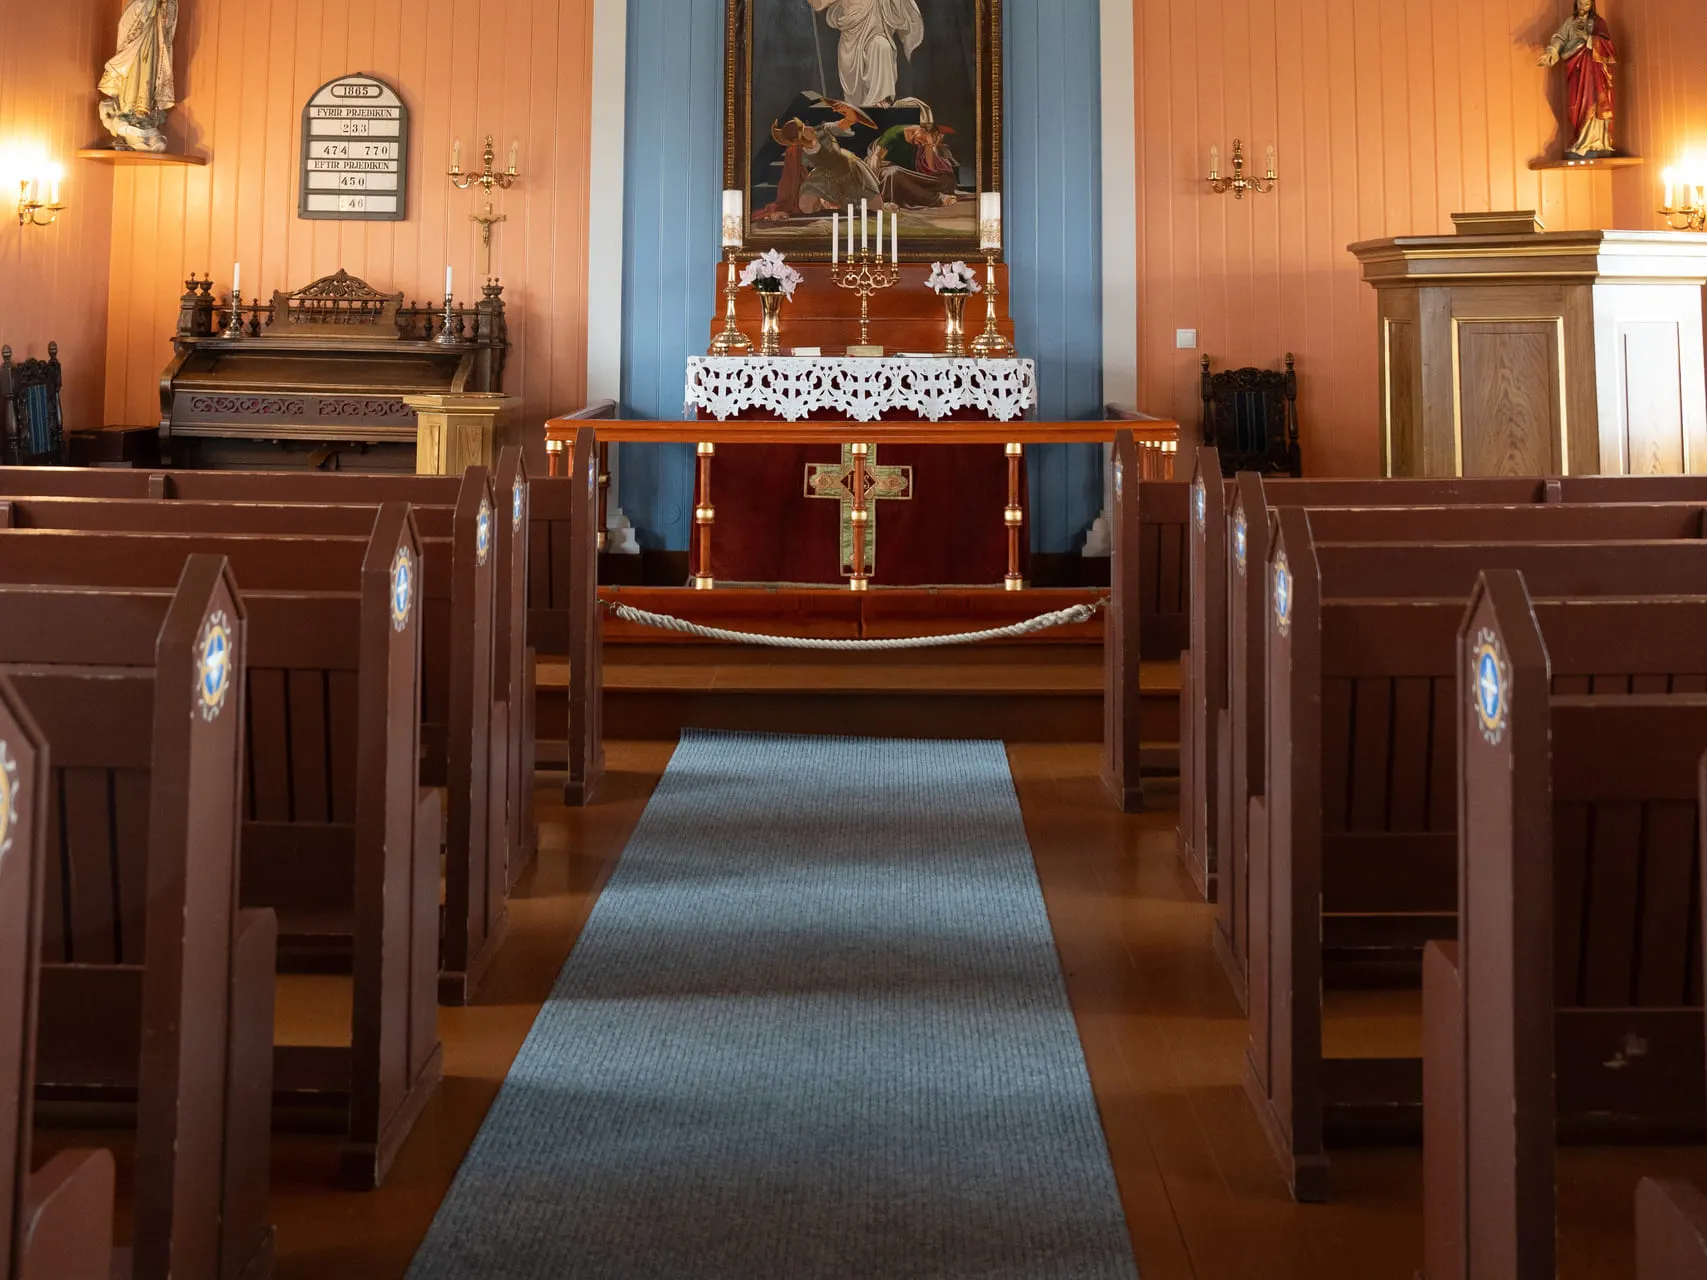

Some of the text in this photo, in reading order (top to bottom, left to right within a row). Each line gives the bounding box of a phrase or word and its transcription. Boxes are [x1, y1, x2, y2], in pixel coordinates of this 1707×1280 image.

[344, 86, 368, 95] 1865
[317, 108, 342, 117] FYRIR
[343, 123, 367, 133] 233
[323, 145, 388, 156] 474 770
[314, 160, 339, 169] EFTIR
[341, 176, 365, 186] 450
